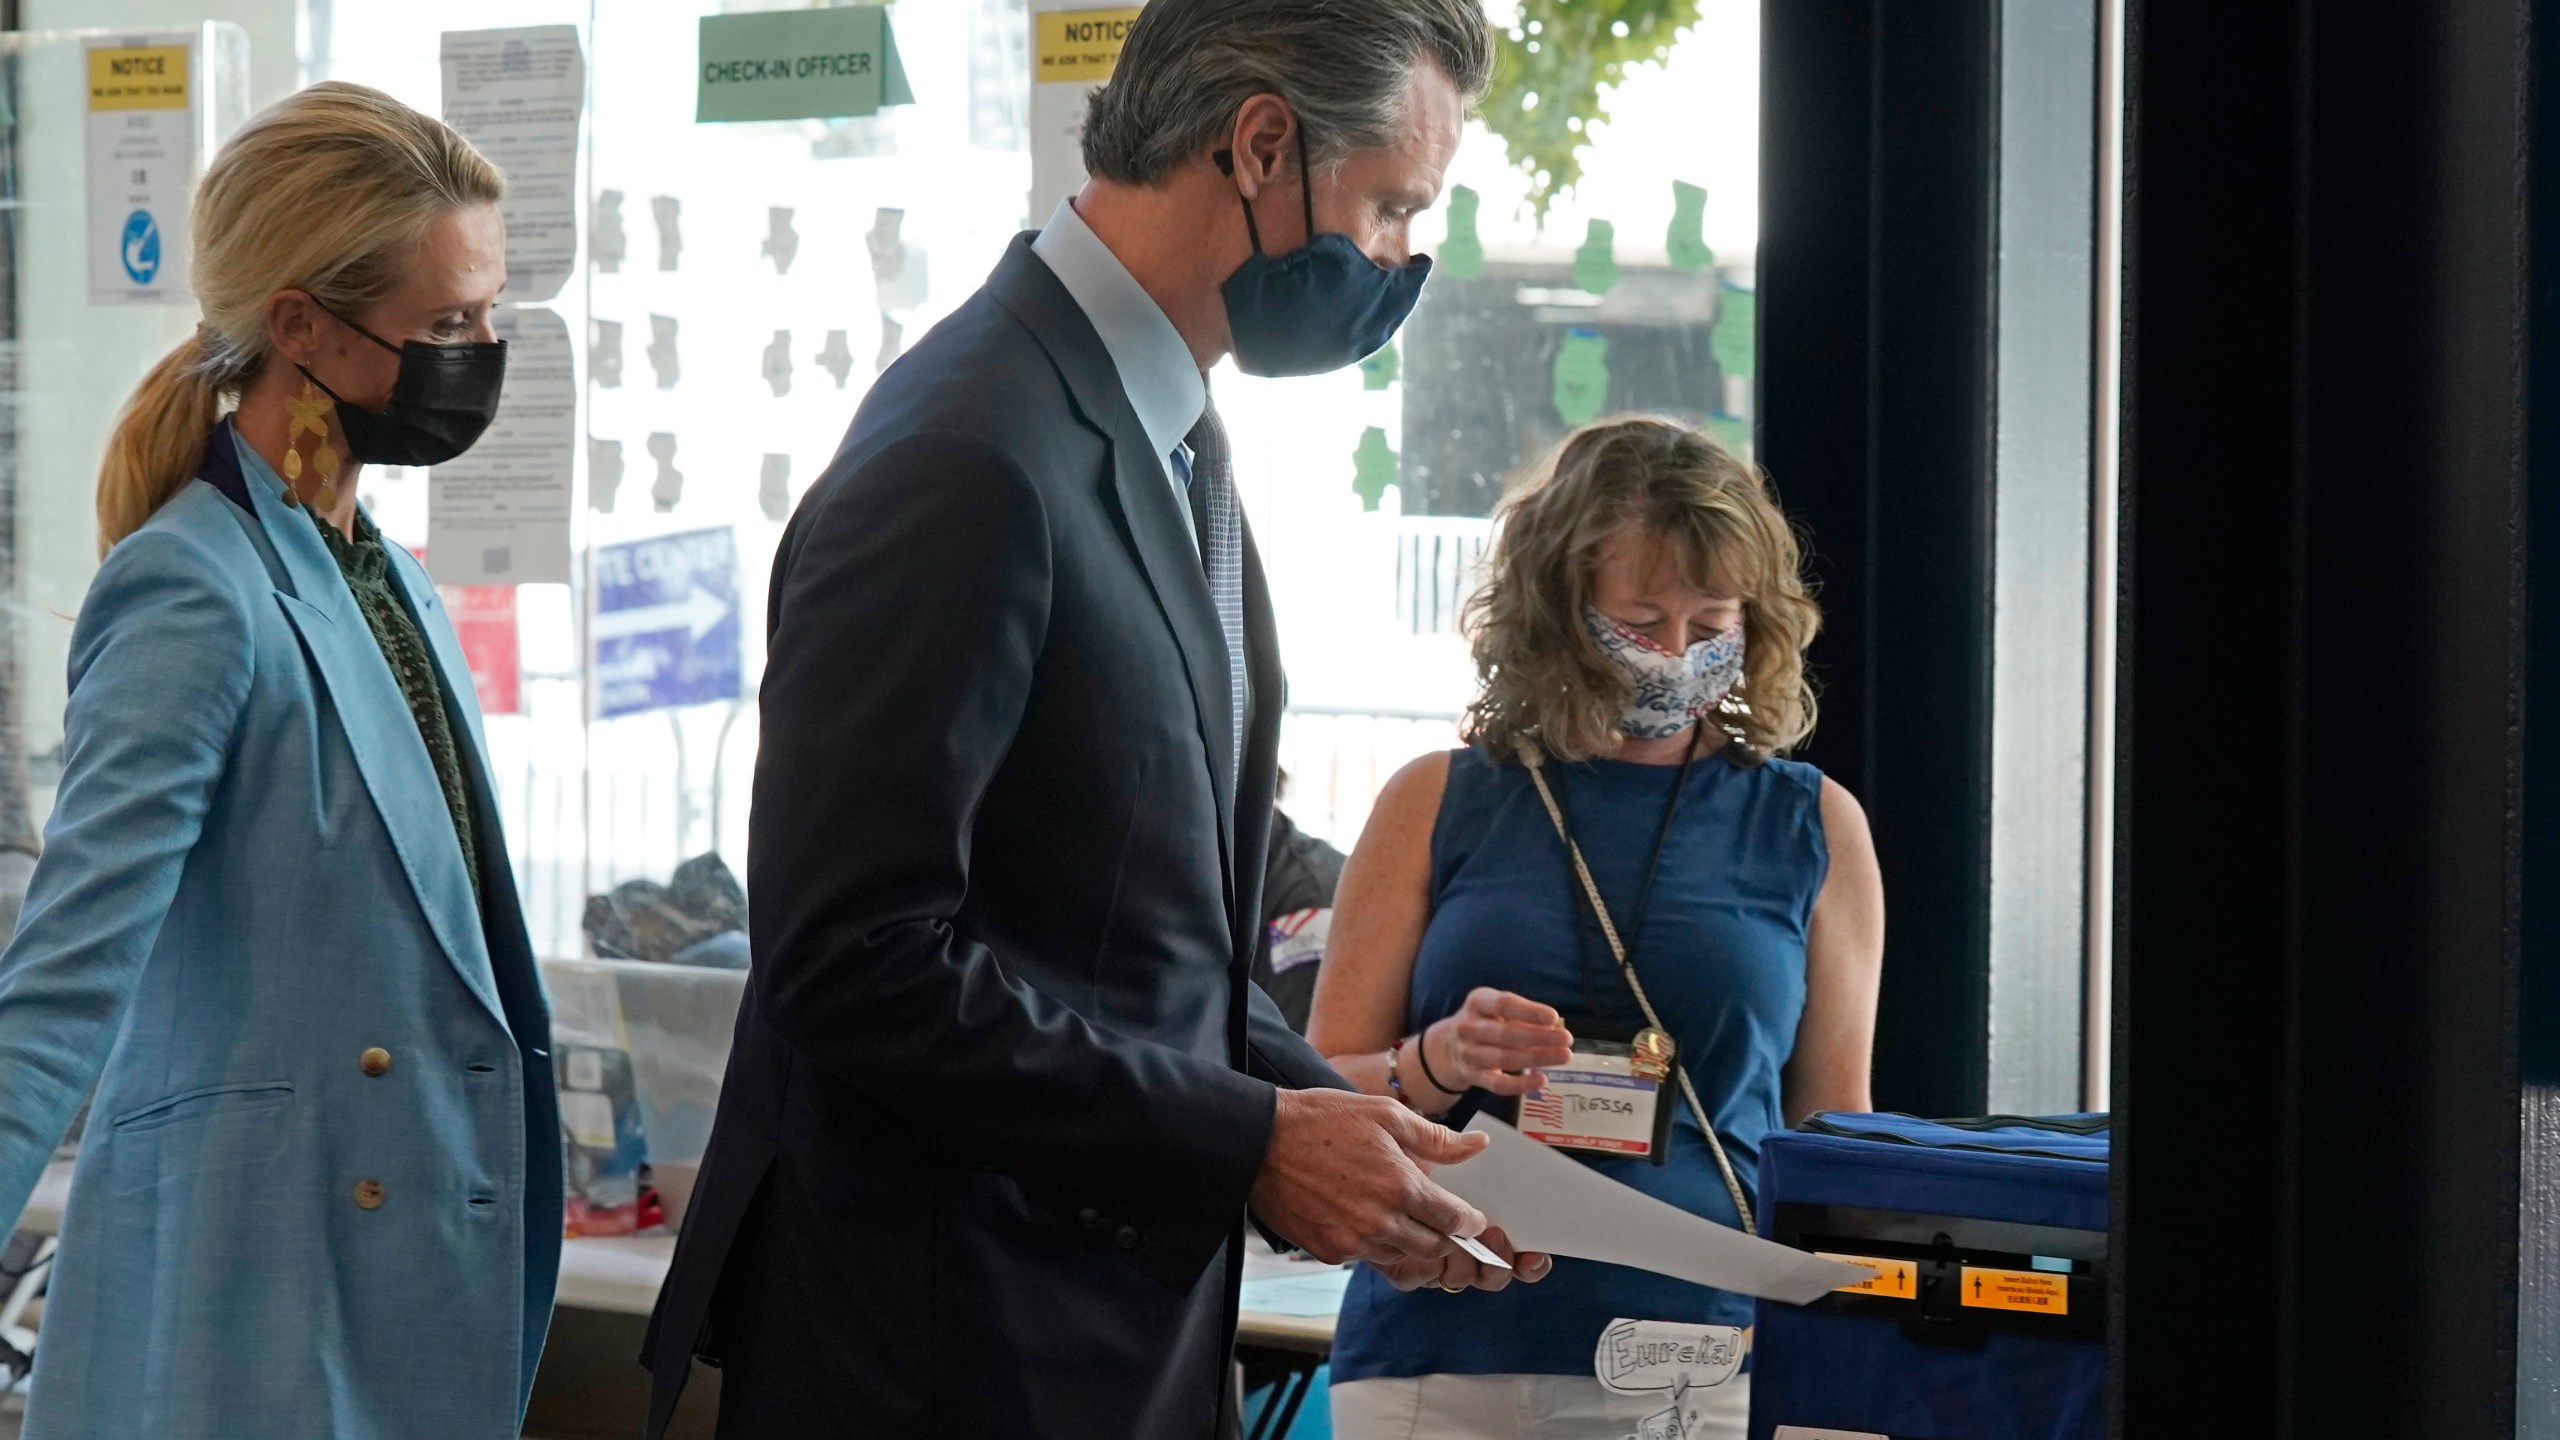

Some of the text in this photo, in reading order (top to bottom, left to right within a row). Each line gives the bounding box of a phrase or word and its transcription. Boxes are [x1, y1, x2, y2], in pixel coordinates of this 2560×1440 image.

[110, 57, 165, 76] NOTICE
[704, 52, 872, 84] CHECK-IN OFFICER
[1082, 53, 1107, 64] THAT
[1564, 1094, 1633, 1116] TRESSA
